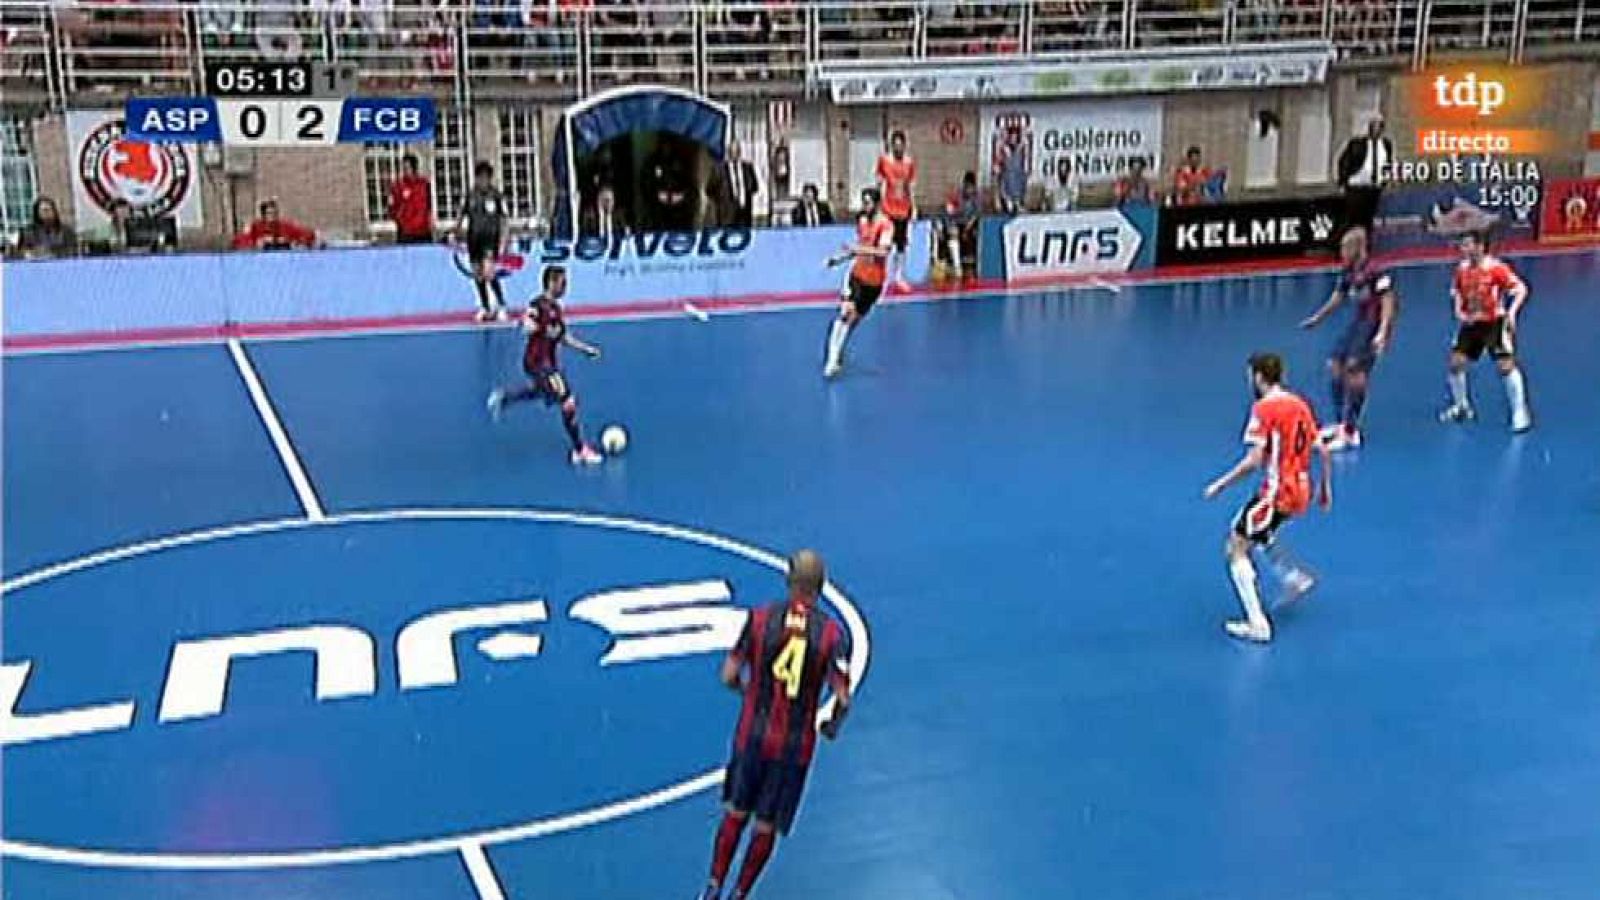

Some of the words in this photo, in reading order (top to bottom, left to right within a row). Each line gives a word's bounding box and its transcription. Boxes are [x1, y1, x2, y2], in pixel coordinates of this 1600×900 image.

[1043, 126, 1142, 151] Gobierno
[1175, 217, 1301, 250] KELME
[772, 635, 806, 698] 4
